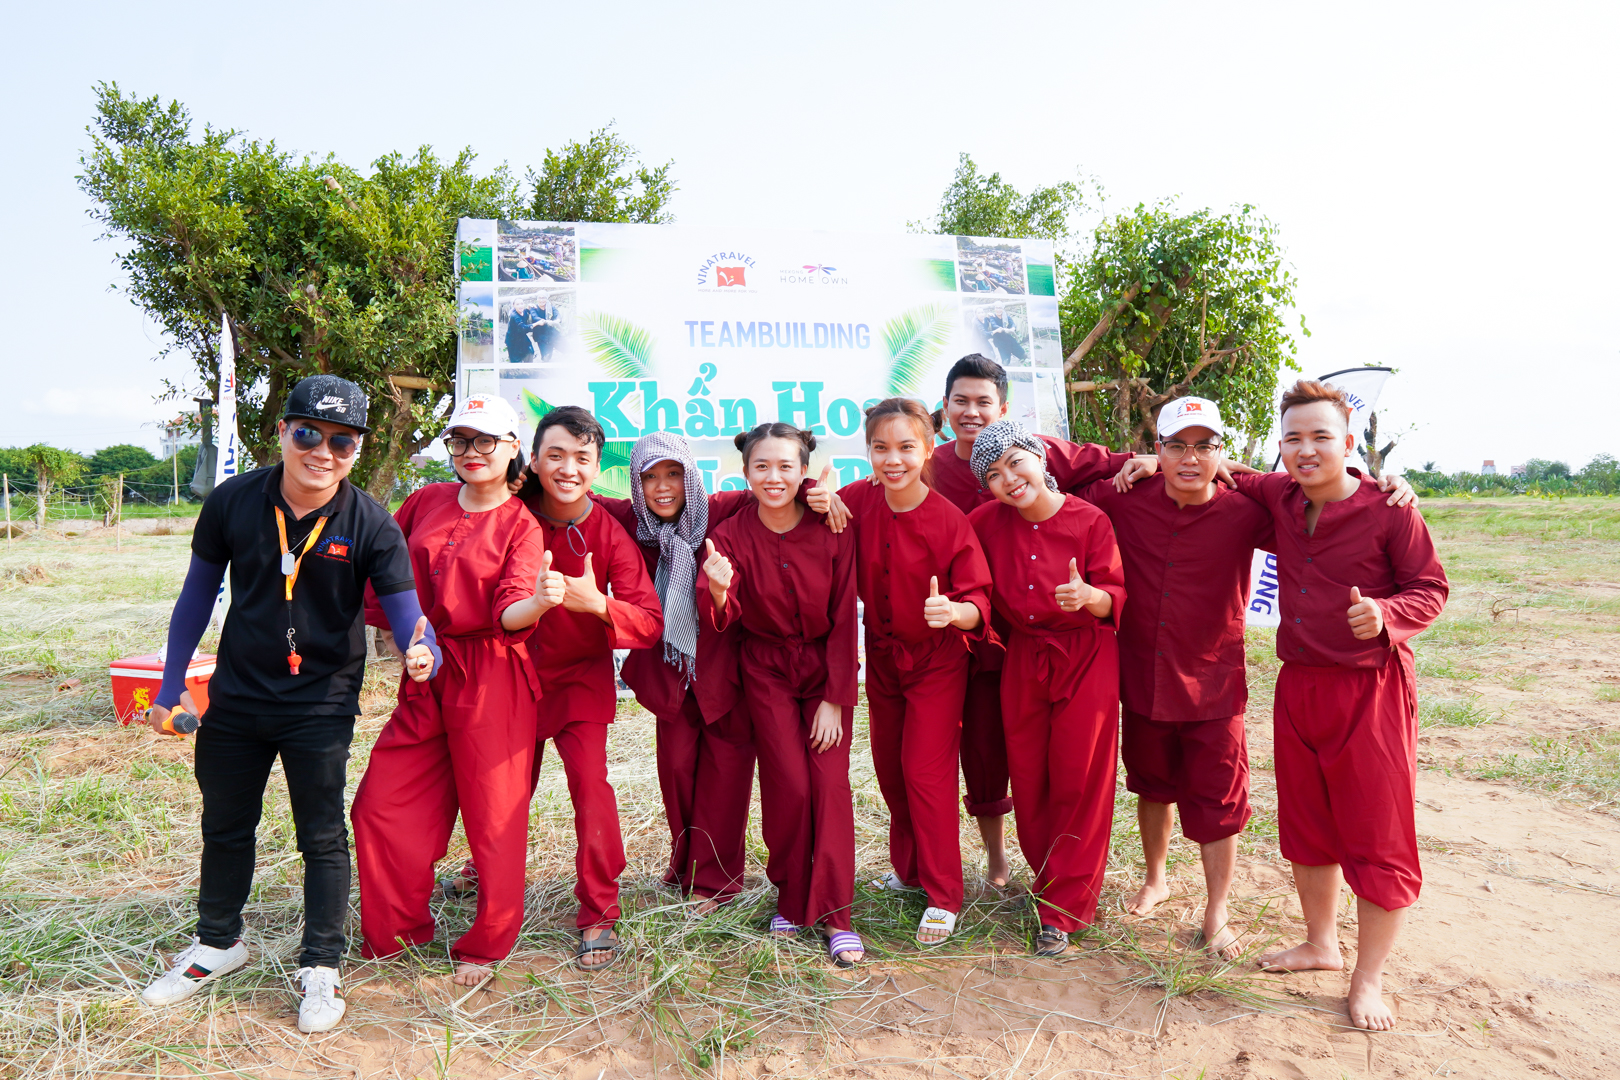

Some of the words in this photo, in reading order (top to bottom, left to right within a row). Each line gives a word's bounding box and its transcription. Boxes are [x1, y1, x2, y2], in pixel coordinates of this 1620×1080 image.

[697, 251, 756, 286] VINATRAVEL
[684, 320, 871, 350] TEAMBUILDING
[321, 395, 345, 404] NIKE
[588, 362, 757, 438] Khẩn
[317, 535, 354, 552] VINATRAVEL
